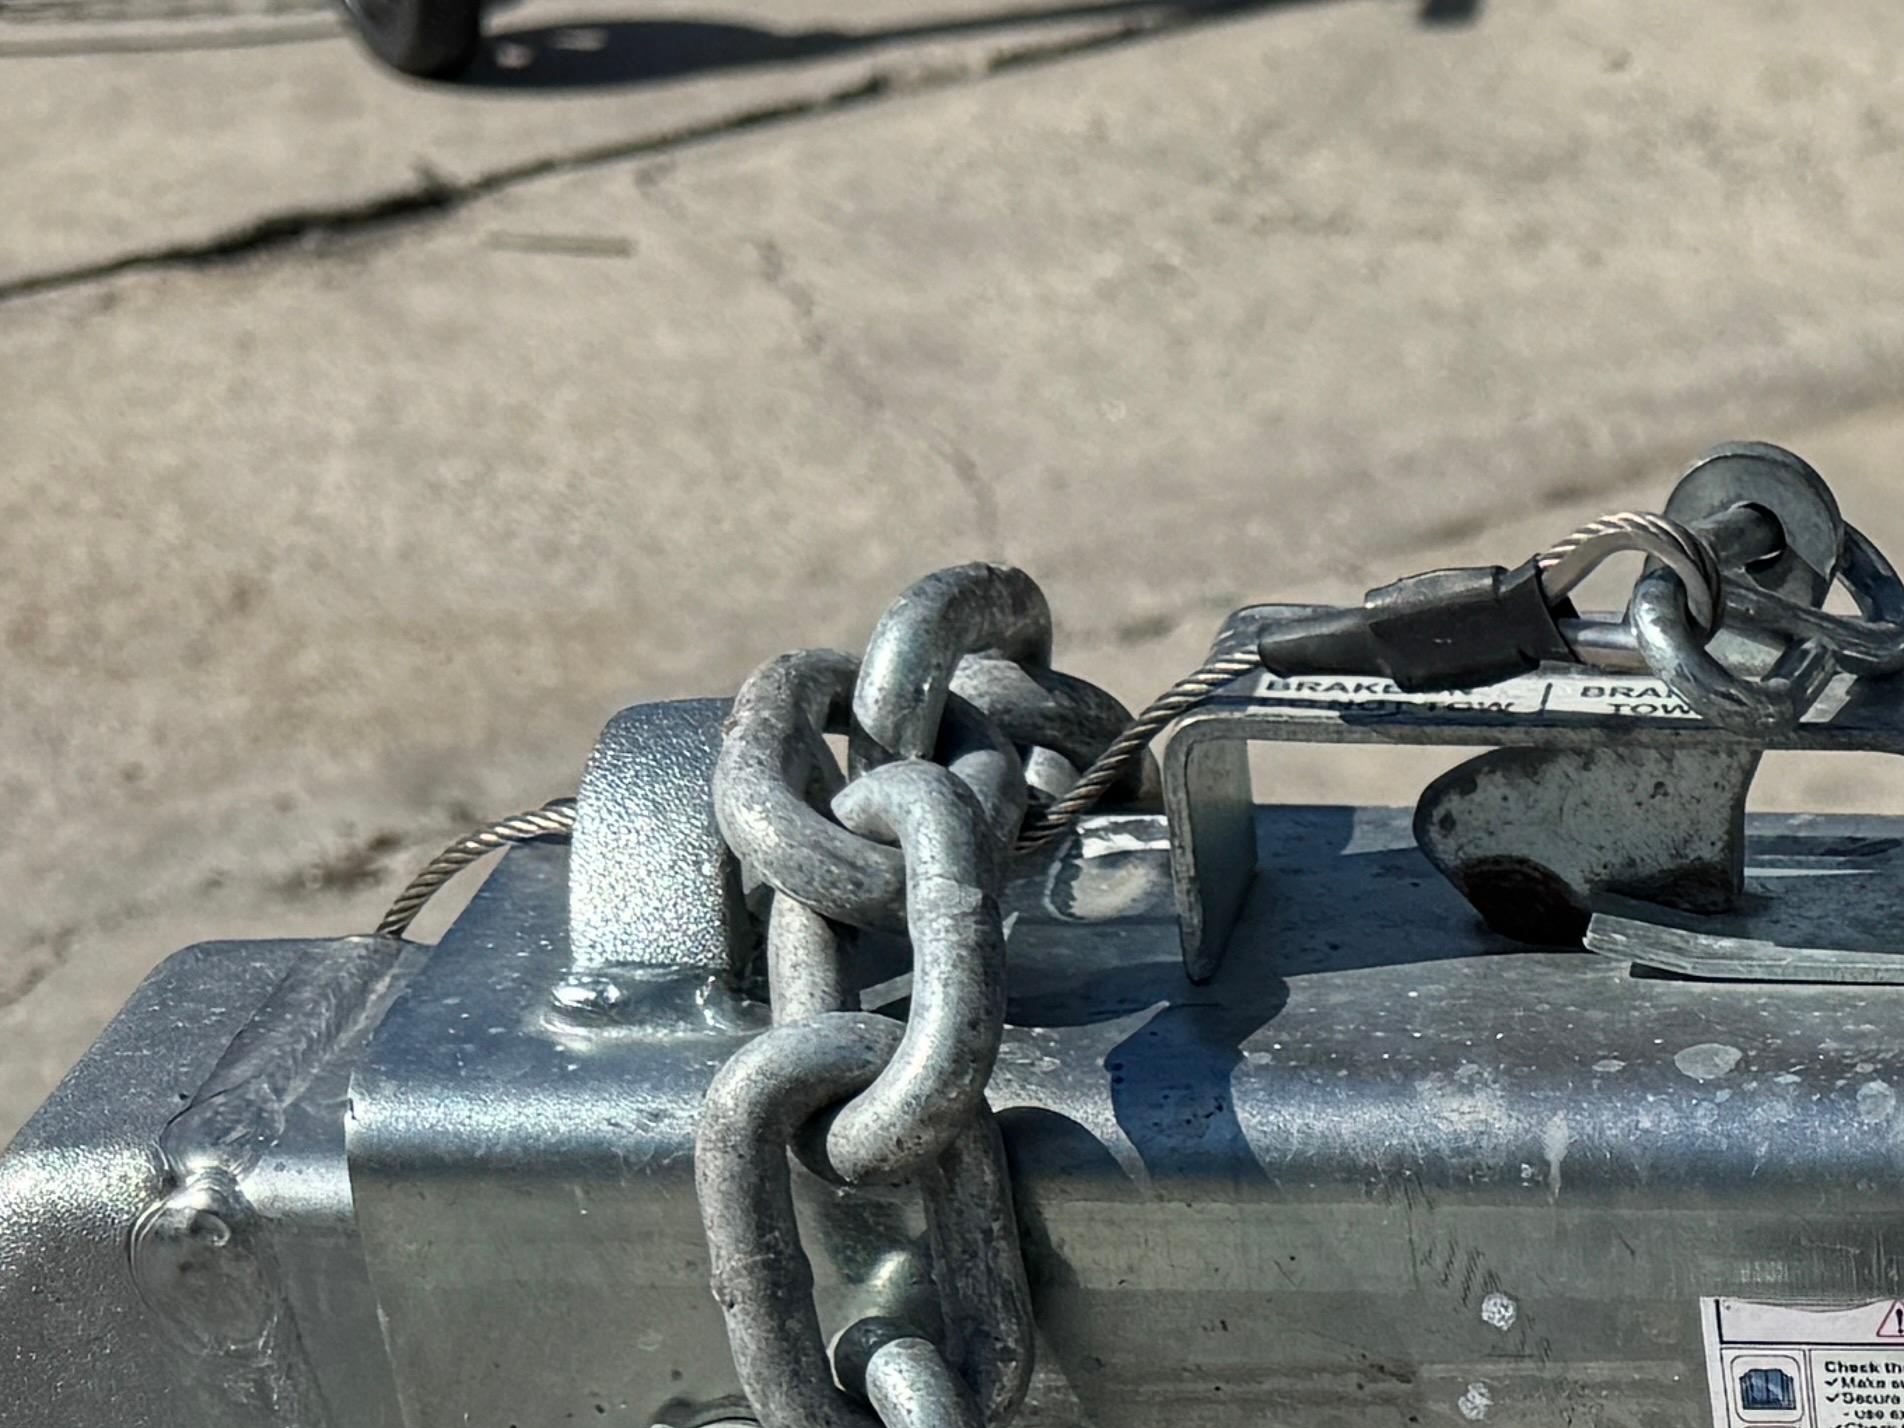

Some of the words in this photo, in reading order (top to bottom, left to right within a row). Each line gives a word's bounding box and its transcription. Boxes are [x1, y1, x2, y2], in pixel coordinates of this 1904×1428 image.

[1825, 1361, 1880, 1374] Check
[1841, 1377, 1886, 1389] Make
[1843, 1393, 1901, 1405] Secure
[1854, 1410, 1885, 1420] use
